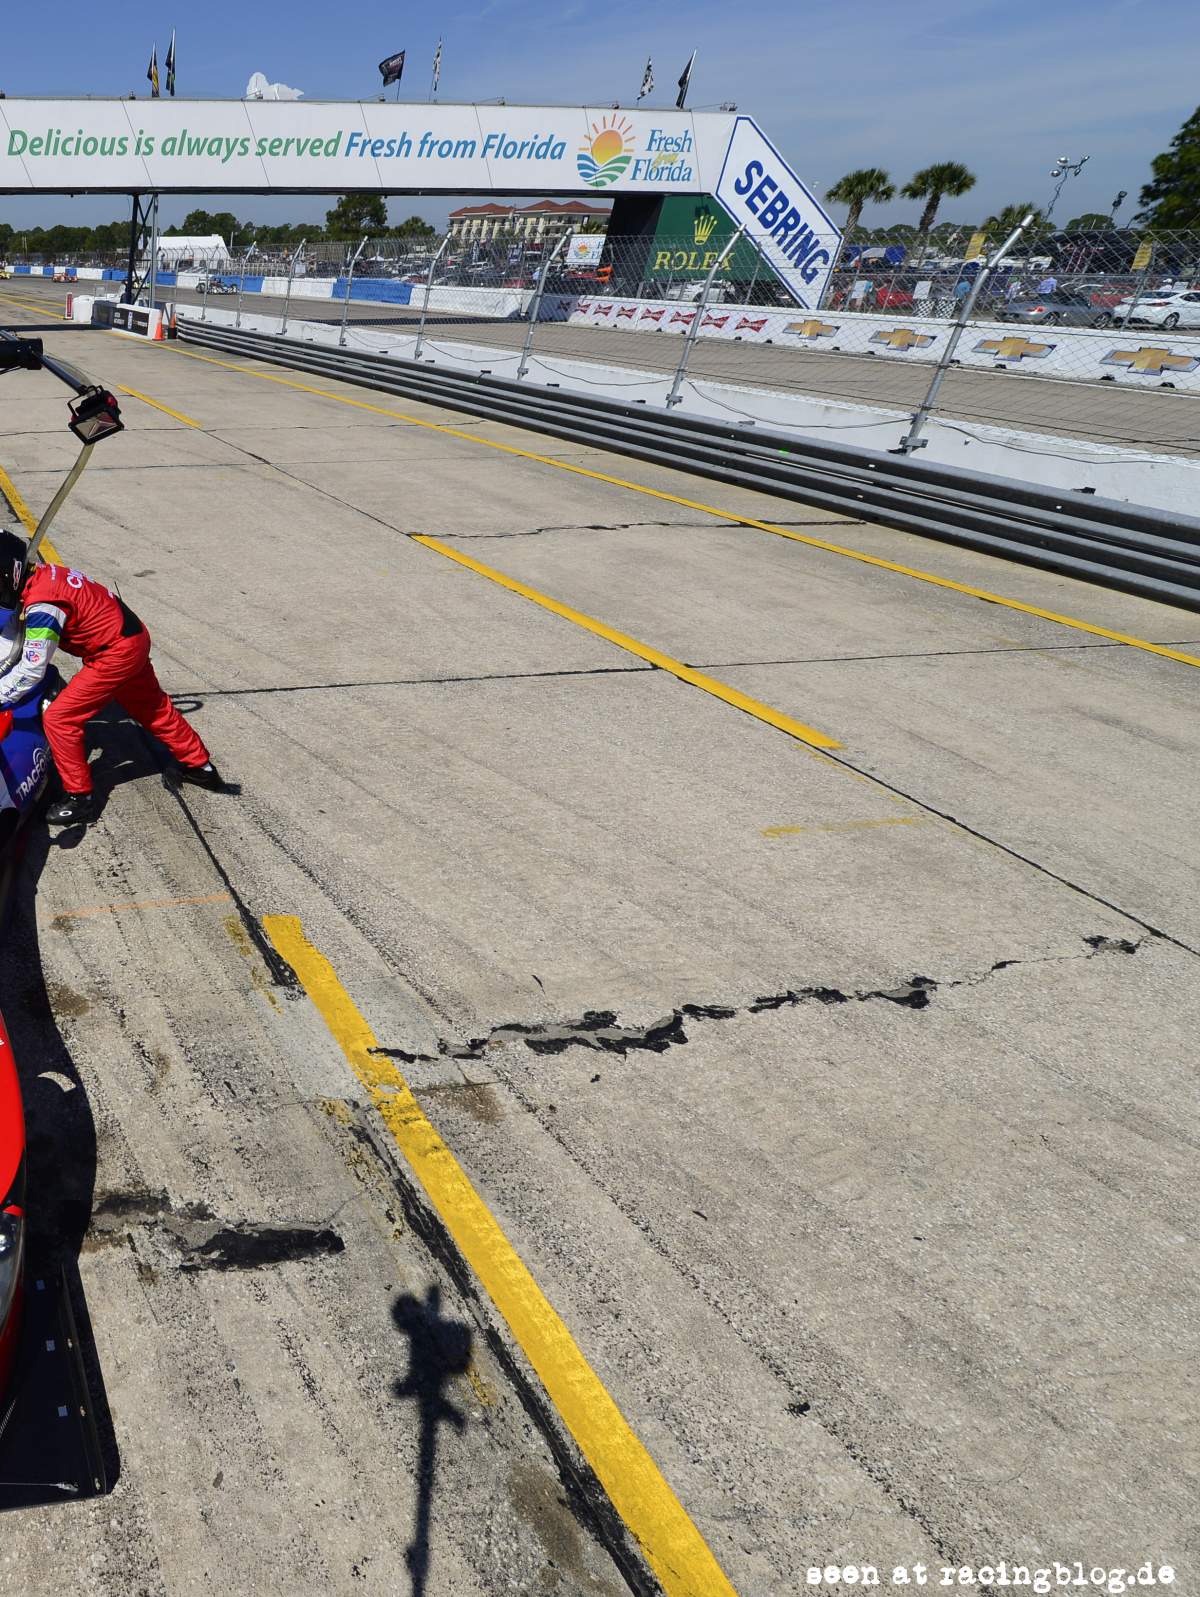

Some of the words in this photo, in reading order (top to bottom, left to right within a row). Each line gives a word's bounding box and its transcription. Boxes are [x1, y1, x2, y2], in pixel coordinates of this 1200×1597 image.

[7, 128, 129, 157] Delicious
[134, 129, 155, 156] is
[161, 129, 251, 164] always
[255, 130, 343, 157] served
[344, 131, 412, 158] Fresh
[416, 131, 477, 159] from
[480, 133, 567, 160] Florida
[645, 128, 693, 153] Fresh
[630, 158, 693, 182] Florida
[734, 160, 830, 285] SEBRING
[653, 251, 736, 271] ROLEX
[16, 757, 48, 801] TRACFO
